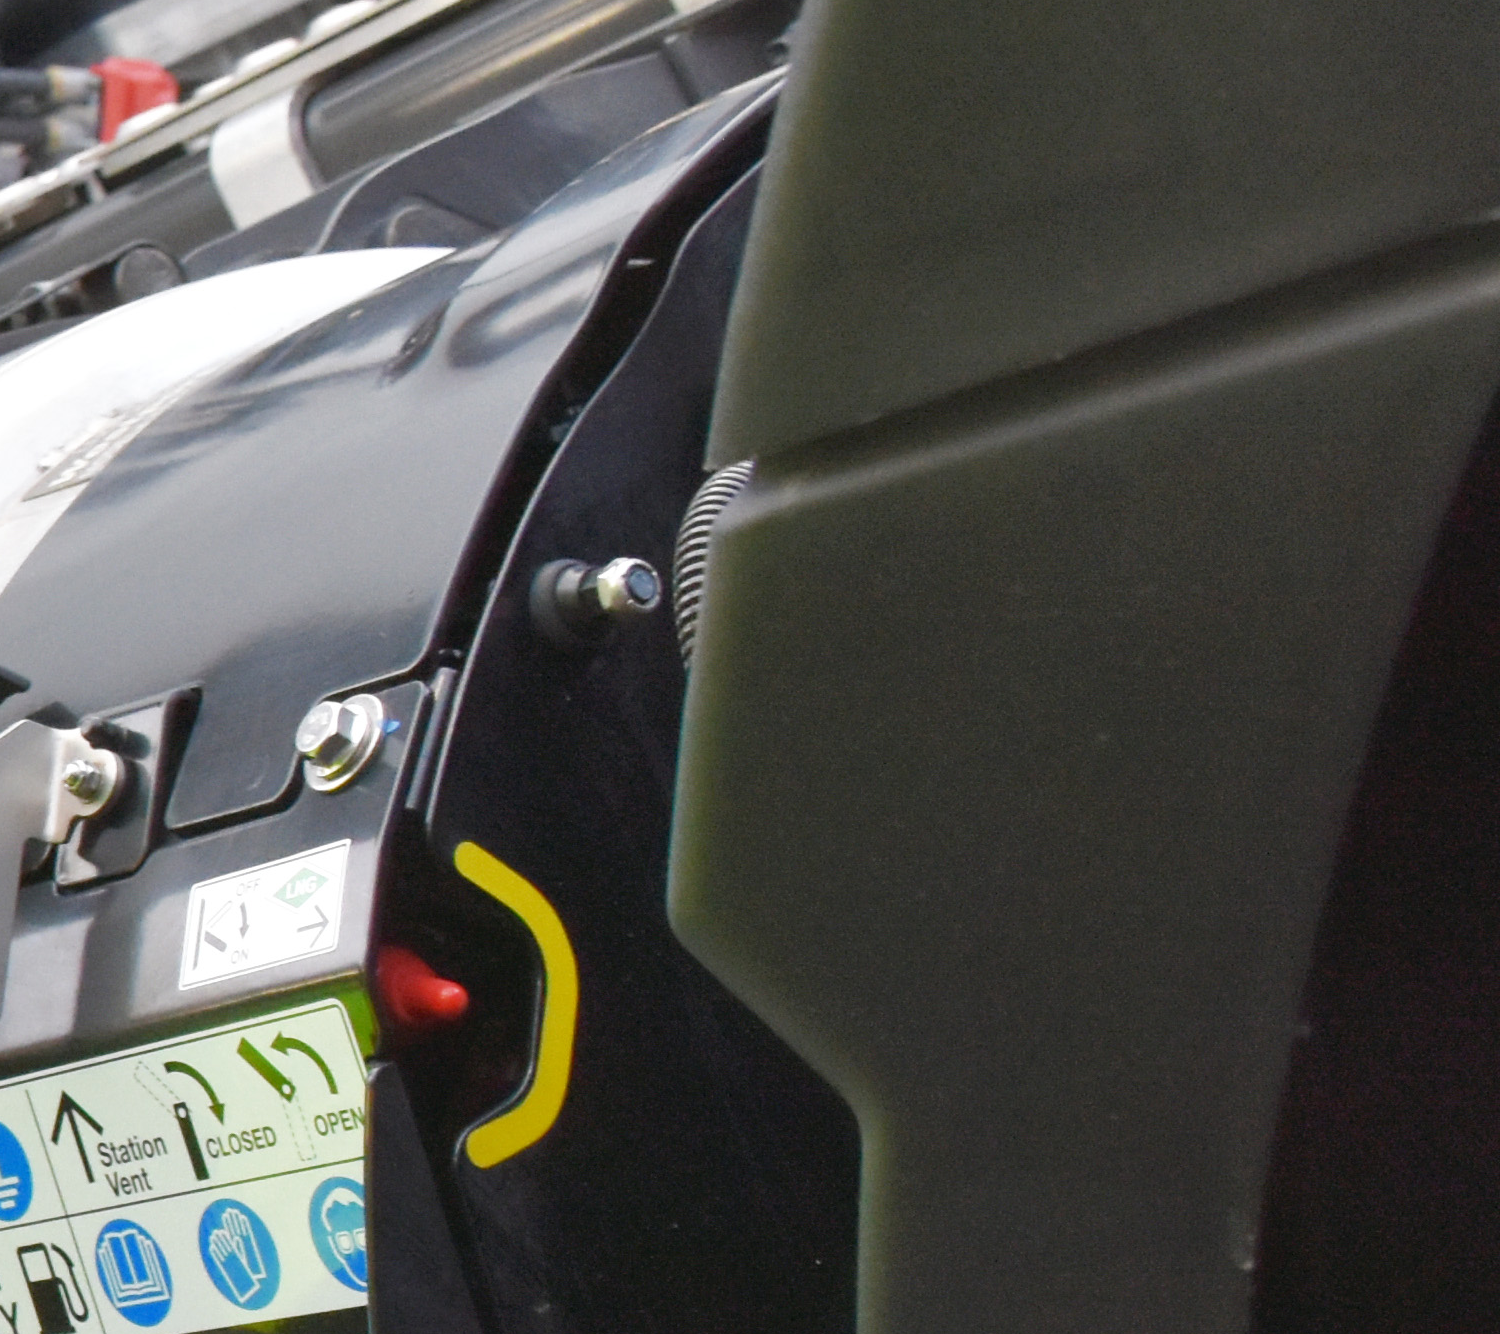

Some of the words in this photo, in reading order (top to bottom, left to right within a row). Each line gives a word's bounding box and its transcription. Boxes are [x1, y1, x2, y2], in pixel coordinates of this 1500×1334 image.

[236, 878, 261, 896] OFF
[285, 875, 318, 900] LNG
[231, 949, 249, 964] ON
[314, 1107, 365, 1137] OPEN
[97, 1135, 168, 1168] Station
[205, 1125, 277, 1159] CLOSED
[105, 1168, 153, 1197] Vent
